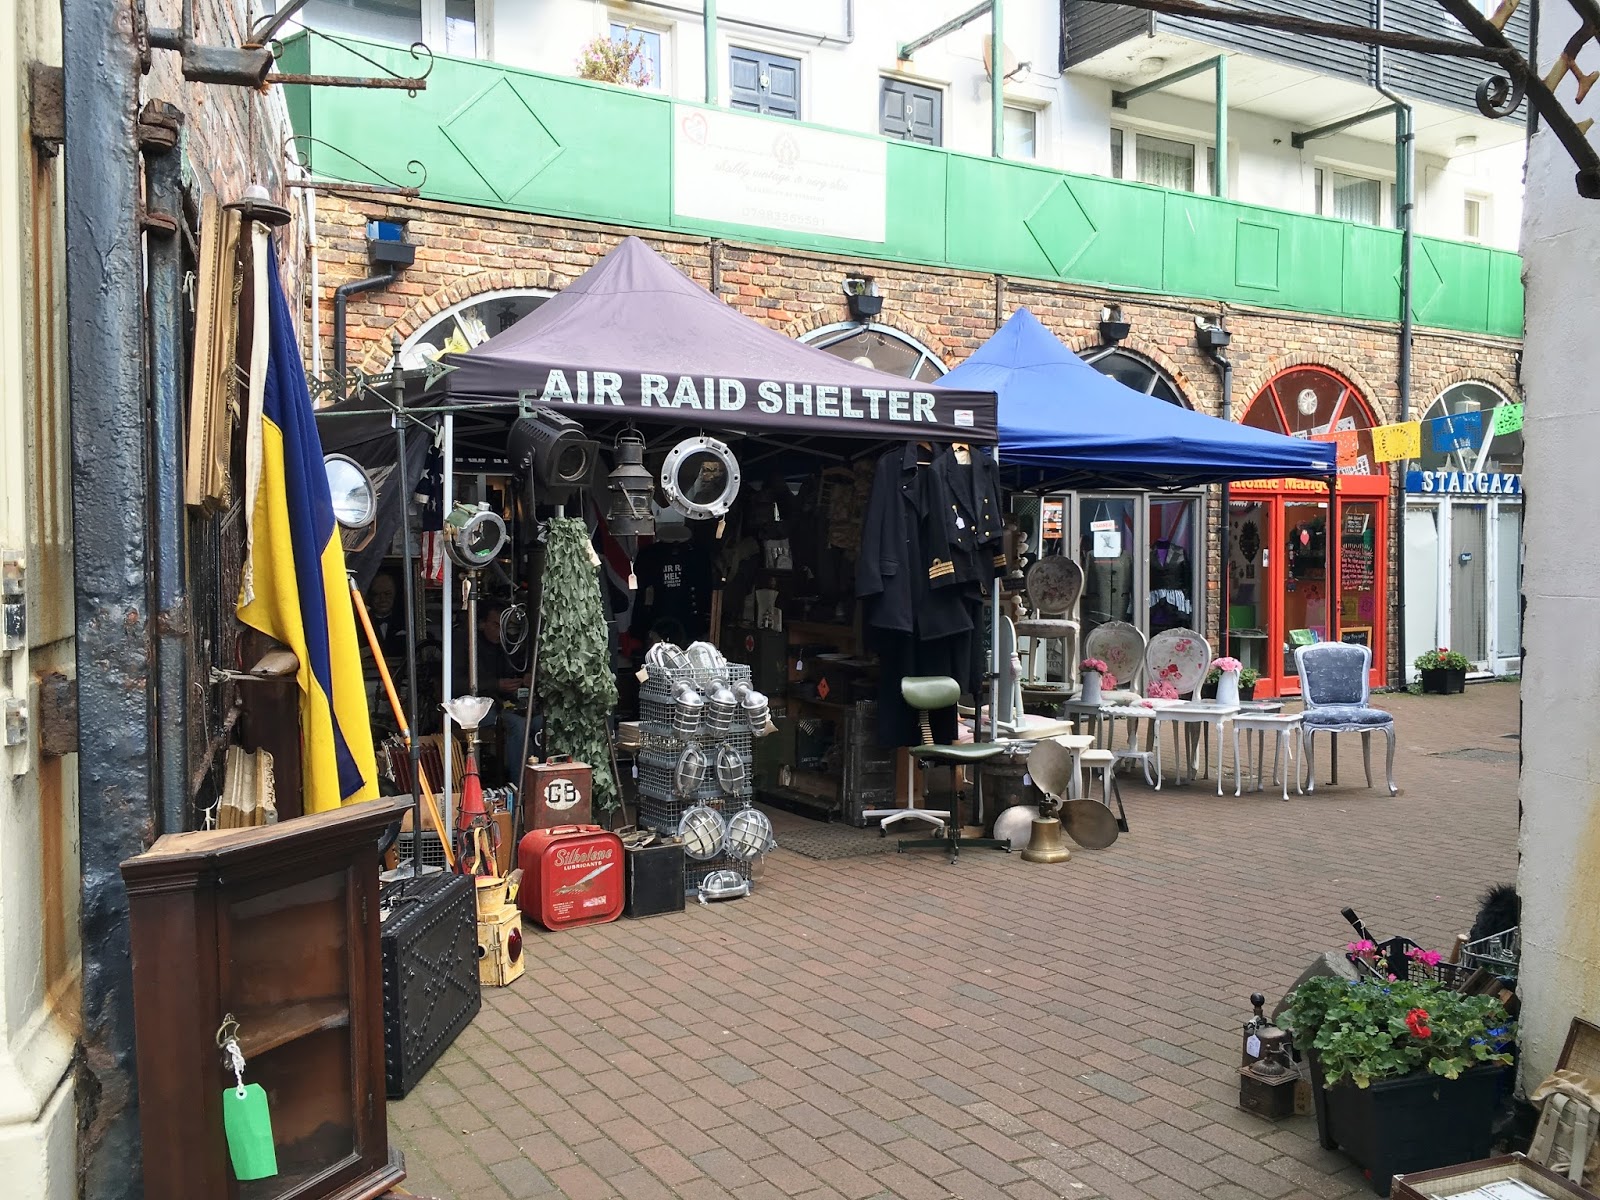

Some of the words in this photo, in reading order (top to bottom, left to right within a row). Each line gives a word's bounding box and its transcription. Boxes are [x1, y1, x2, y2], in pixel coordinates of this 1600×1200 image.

[539, 369, 625, 407] AIR
[640, 373, 746, 411] RAID
[757, 382, 939, 423] SHELTER
[1284, 477, 1343, 494] Marigod
[548, 782, 576, 804] GB
[563, 860, 603, 871] LUBRICANTS
